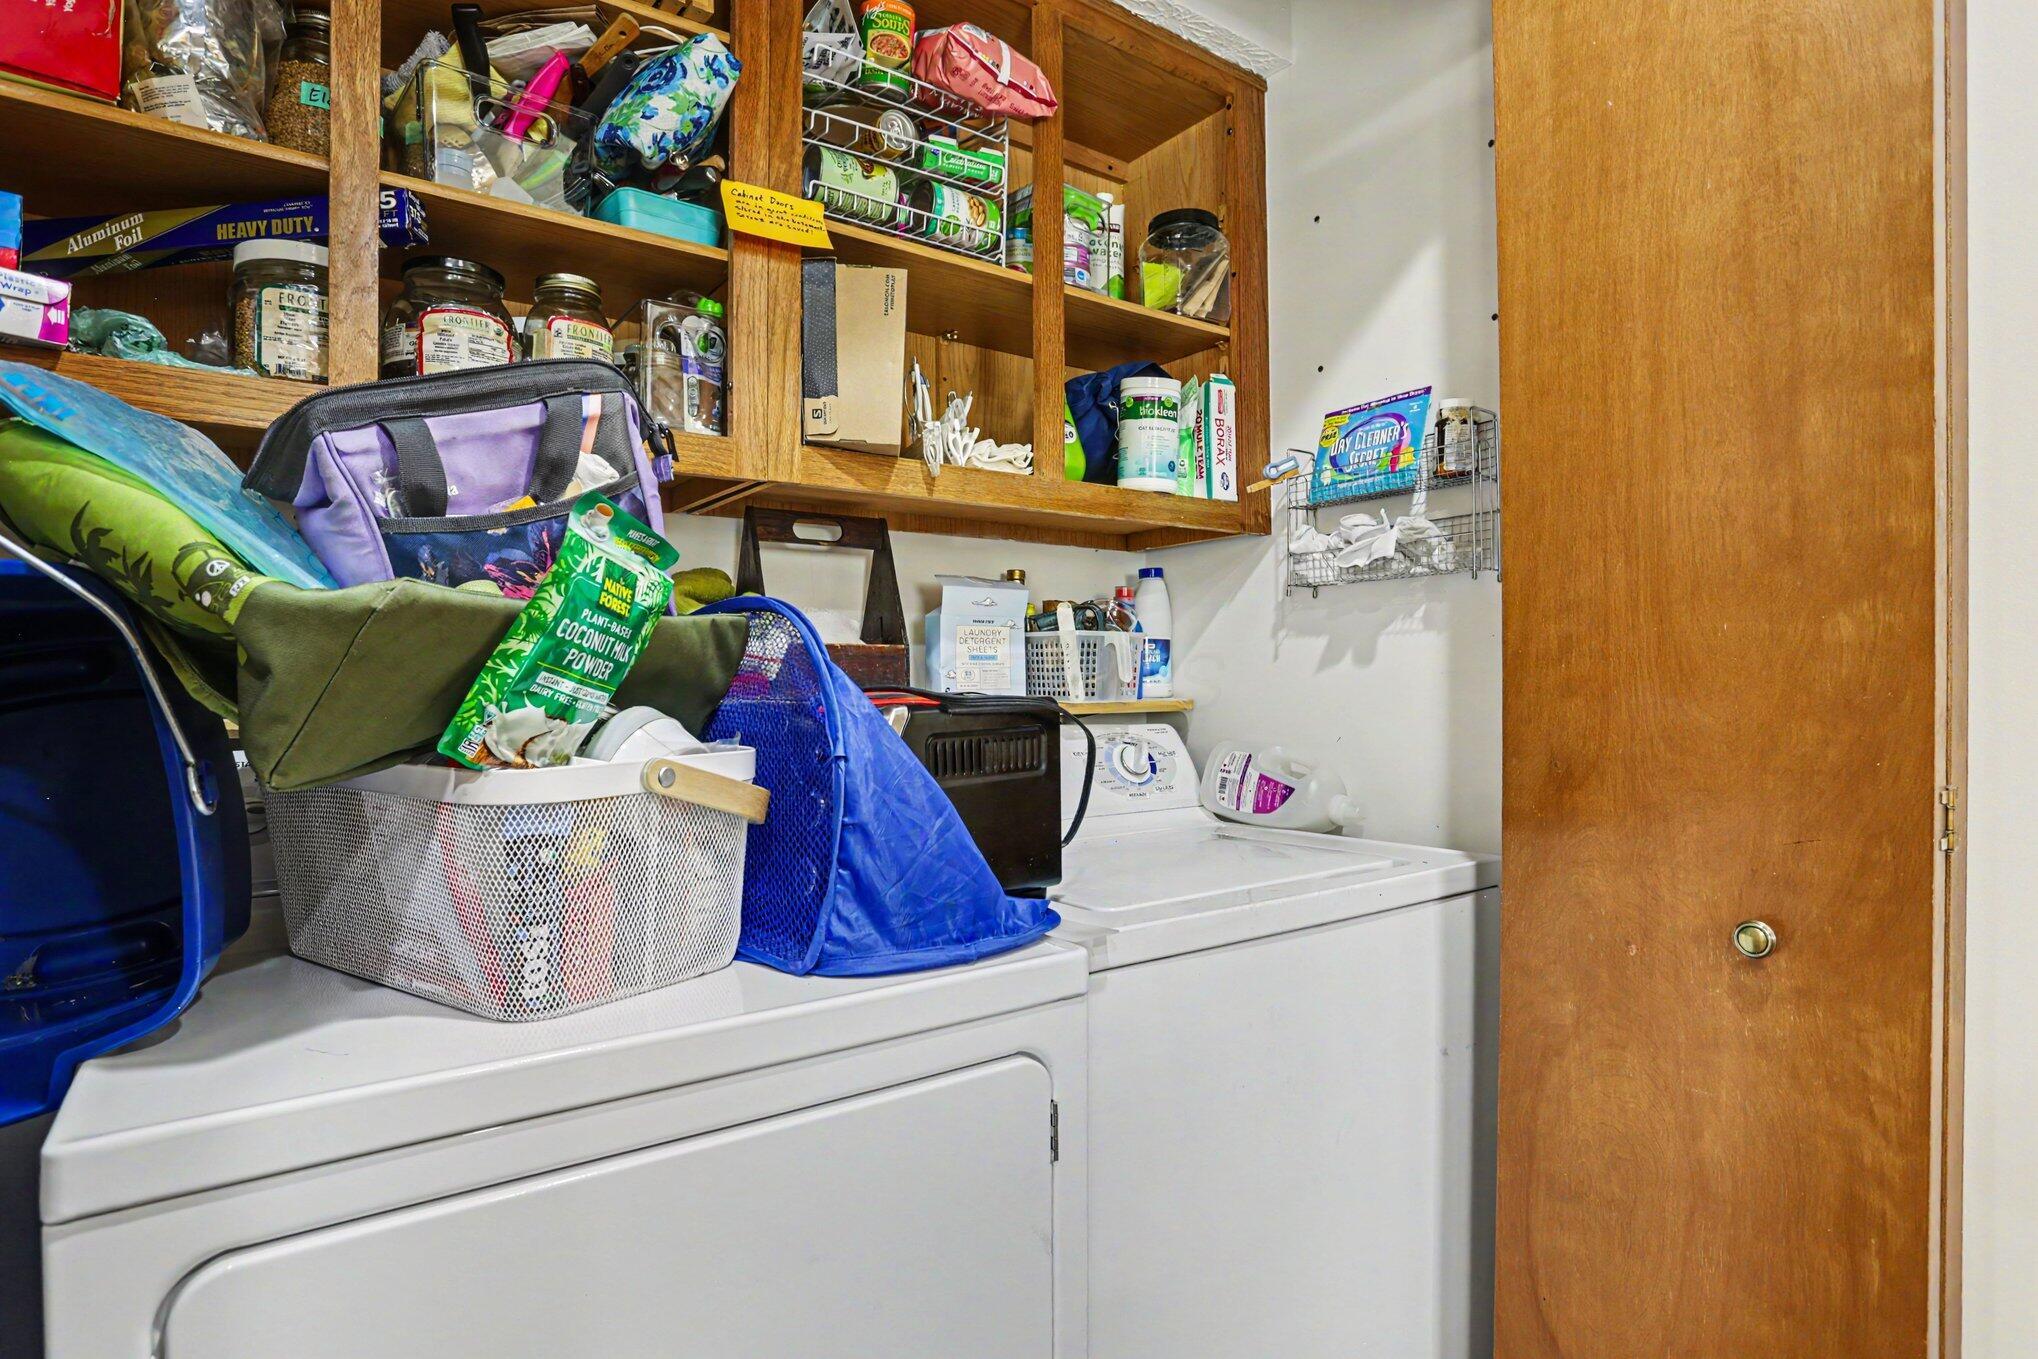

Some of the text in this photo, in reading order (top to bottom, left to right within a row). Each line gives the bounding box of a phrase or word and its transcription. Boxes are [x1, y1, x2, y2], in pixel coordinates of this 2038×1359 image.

[730, 187, 795, 211] Cabinet Doors
[67, 212, 145, 255] Aluminum
[114, 226, 144, 252] Foil
[216, 215, 314, 241] HEAVY DUTY
[0, 280, 32, 297] Wrap
[1214, 417, 1226, 467] BORAX
[603, 577, 633, 601] NATIVE
[598, 592, 630, 618] FOREST
[555, 617, 634, 664] COCONUT MILK
[963, 628, 1003, 637] LAUNDRY
[966, 645, 999, 654] SHEETS
[562, 648, 615, 682] POWDER
[529, 683, 554, 701] DAIRY
